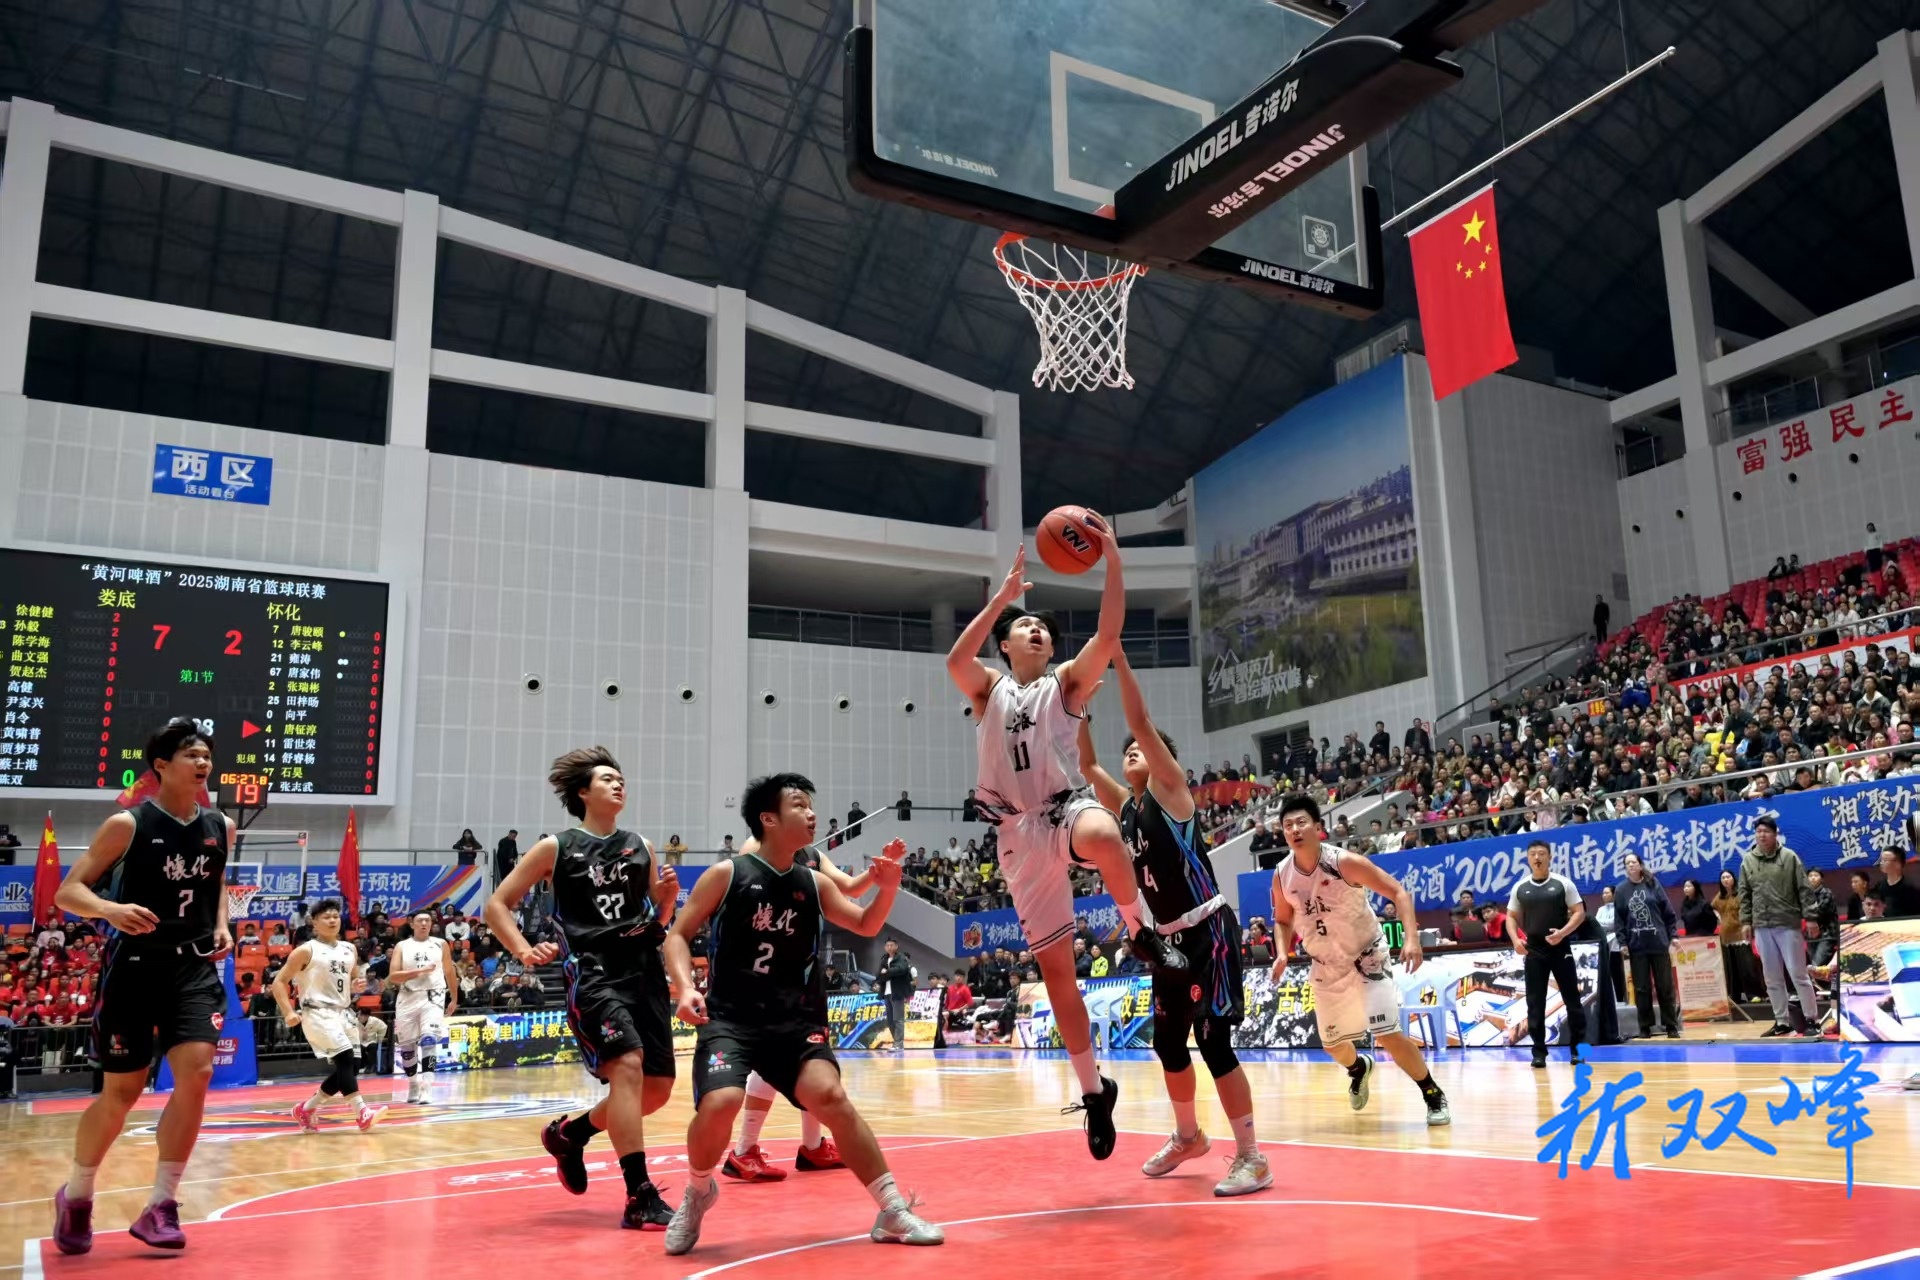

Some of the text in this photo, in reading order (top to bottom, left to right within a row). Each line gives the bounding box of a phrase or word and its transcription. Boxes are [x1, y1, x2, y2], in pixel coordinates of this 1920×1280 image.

[1736, 390, 1913, 475] 富强民主
[171, 448, 256, 488] 西区
[97, 588, 136, 609] 娄底
[112, 612, 120, 622] 2
[267, 602, 301, 621] 怀化
[13, 620, 39, 632] 孙毅
[111, 627, 119, 637] 2
[272, 625, 279, 634] 7
[374, 631, 381, 641] 0
[152, 624, 171, 650] 7
[223, 629, 243, 656] 2
[110, 641, 118, 652] 3
[272, 639, 381, 655] 12 李云峰 0
[11, 649, 117, 667] 曲文强 0
[271, 653, 282, 662] 21
[372, 660, 379, 670] 2
[9, 665, 115, 681] 贺赵杰 0
[179, 668, 214, 684] 第1节
[270, 667, 281, 676] 67
[372, 672, 379, 683] 0
[7, 680, 114, 697] 高健 0
[268, 681, 275, 690] 2
[371, 686, 378, 696] 0
[6, 696, 112, 711] 尹家兴 0
[267, 696, 280, 704] 25
[370, 700, 377, 710] 0
[5, 711, 111, 727] 肖令 0
[266, 709, 377, 724] 0 向平 0
[101, 731, 110, 742] 0
[265, 724, 272, 733] 4
[368, 728, 376, 738] 0
[100, 746, 108, 757] 0
[265, 738, 375, 752] 11 雷世荣 0
[121, 748, 143, 760] 犯规
[236, 753, 256, 764] 犯规
[264, 753, 275, 762] 14
[367, 755, 374, 766] 0
[1013, 740, 1031, 772] 11
[98, 762, 107, 772] 0
[365, 770, 373, 780] 0
[97, 777, 105, 787] 0
[122, 769, 135, 788] 0
[220, 773, 268, 786] 06:27.8
[235, 783, 259, 804] 19
[365, 784, 372, 794] 0
[1141, 864, 1159, 892] 4
[178, 889, 194, 918] 7
[597, 892, 625, 920] 27
[1315, 920, 1327, 936] 5
[752, 941, 775, 975] 2
[336, 979, 344, 993] 9
